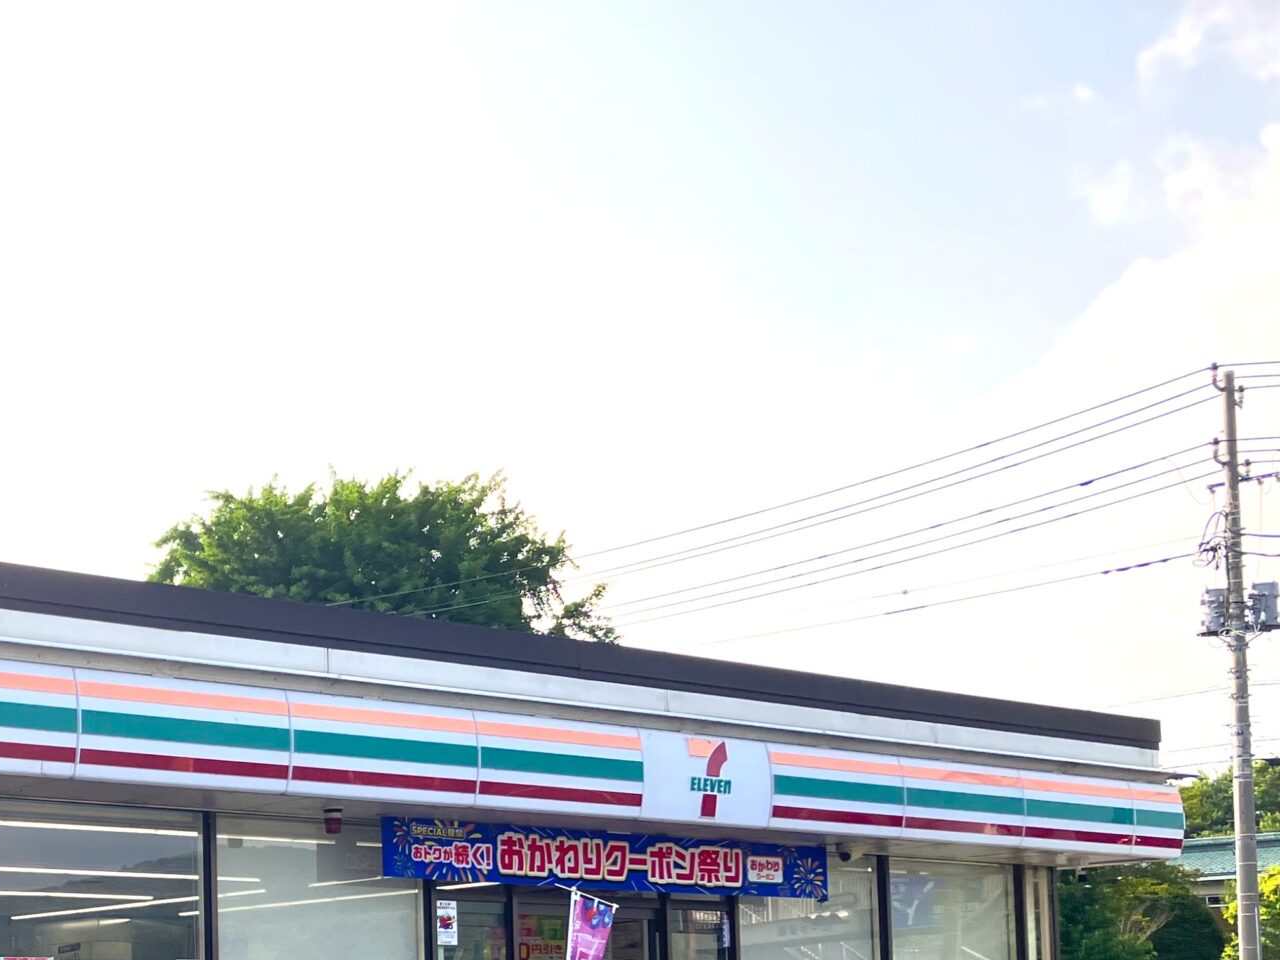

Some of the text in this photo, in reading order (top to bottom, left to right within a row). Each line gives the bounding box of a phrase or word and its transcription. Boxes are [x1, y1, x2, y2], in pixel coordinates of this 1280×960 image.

[498, 833, 742, 887] おかわりクーポン祭り
[750, 860, 780, 872] おかわり
